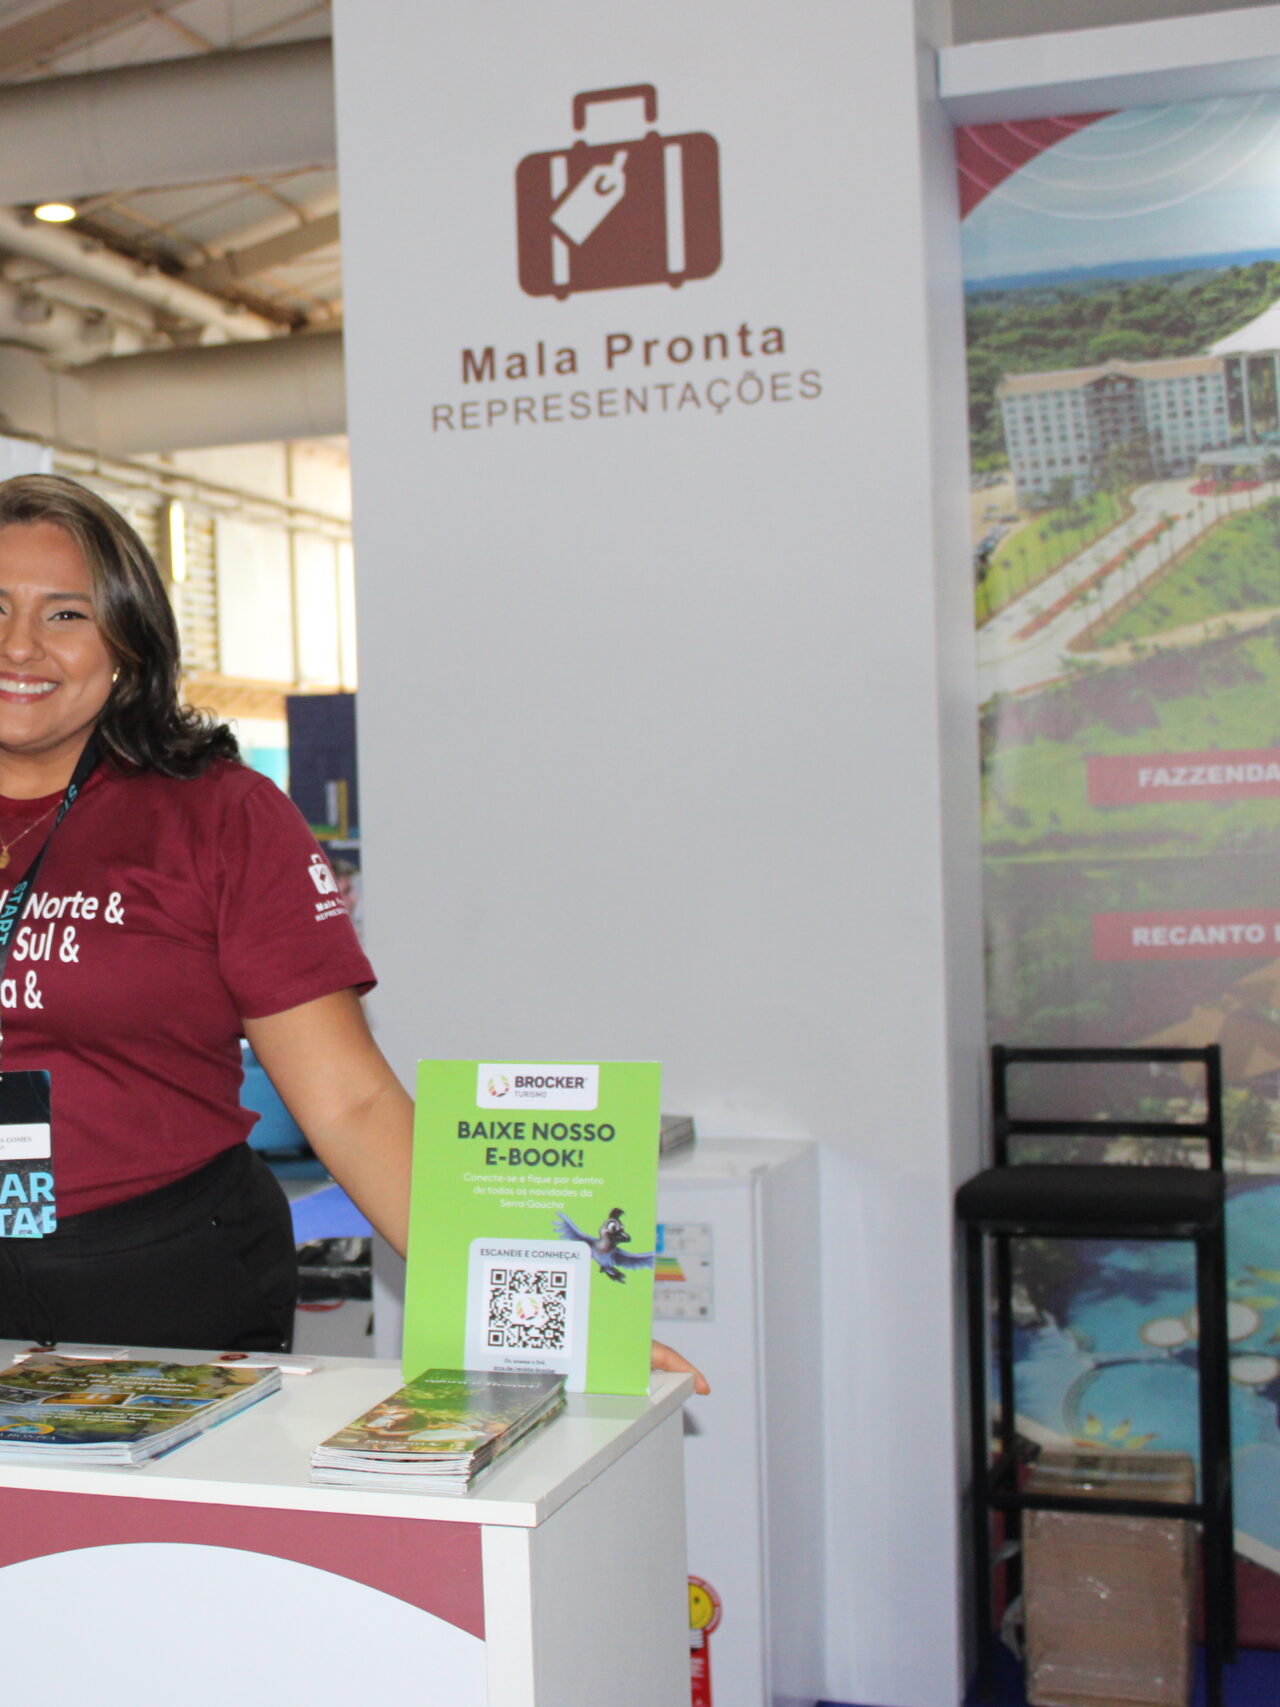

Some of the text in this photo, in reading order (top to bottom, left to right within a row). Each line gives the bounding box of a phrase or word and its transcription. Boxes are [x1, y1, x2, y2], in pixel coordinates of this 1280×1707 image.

[461, 323, 786, 384] Mala Pronta
[432, 370, 823, 432] REPRESENTAÇÕES
[1138, 763, 1280, 788] FAZZENDA
[22, 891, 99, 920] Norte
[104, 891, 126, 925] &
[13, 922, 55, 961] Sul
[58, 926, 80, 963] &
[1132, 924, 1266, 947] RECANTO
[24, 970, 44, 1009] &
[514, 1076, 585, 1089] BROCKER
[514, 1090, 548, 1098] TURISMO
[457, 1121, 616, 1142] BAIXE NOSSO
[485, 1147, 584, 1168] E-BOOK!
[463, 1173, 518, 1183] Conecte-se
[527, 1174, 552, 1186] fique
[553, 1176, 570, 1187] por
[572, 1175, 605, 1185] dentro
[473, 1186, 486, 1195] de
[528, 1187, 578, 1197] novidades
[499, 1199, 526, 1209] Serra
[480, 1248, 581, 1260] ESCANEIE E CONHEÇA!
